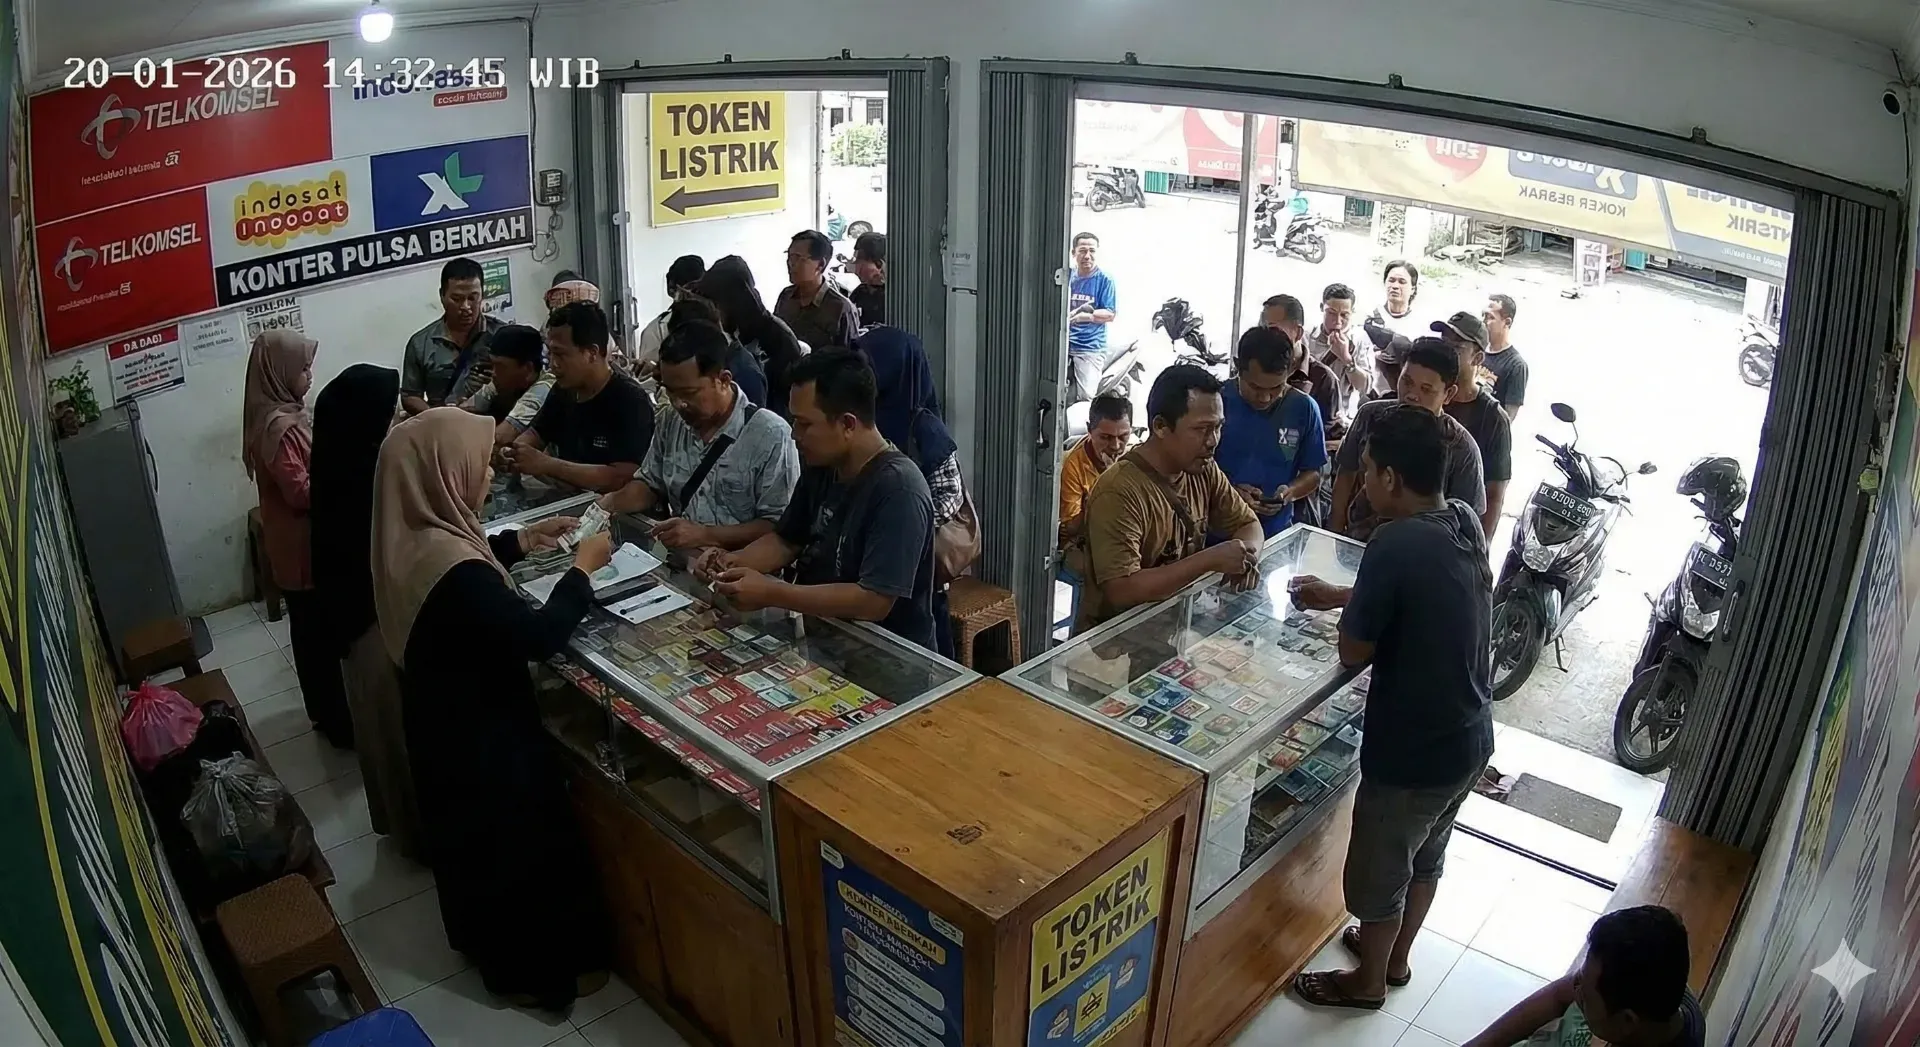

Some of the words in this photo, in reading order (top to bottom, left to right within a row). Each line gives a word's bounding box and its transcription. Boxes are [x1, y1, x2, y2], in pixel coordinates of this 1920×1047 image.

[143, 86, 280, 131] TELKOMSEL
[667, 100, 771, 136] TOKEN
[659, 140, 780, 180] LISTRIK
[241, 180, 341, 216] indosat
[100, 222, 202, 266] TELKOMSEL
[229, 253, 336, 297] KONTER
[342, 236, 423, 272] PULSA
[430, 215, 526, 253] BERKAH
[1051, 857, 1148, 950] TOKEN
[1041, 885, 1153, 993] LISTRIK
